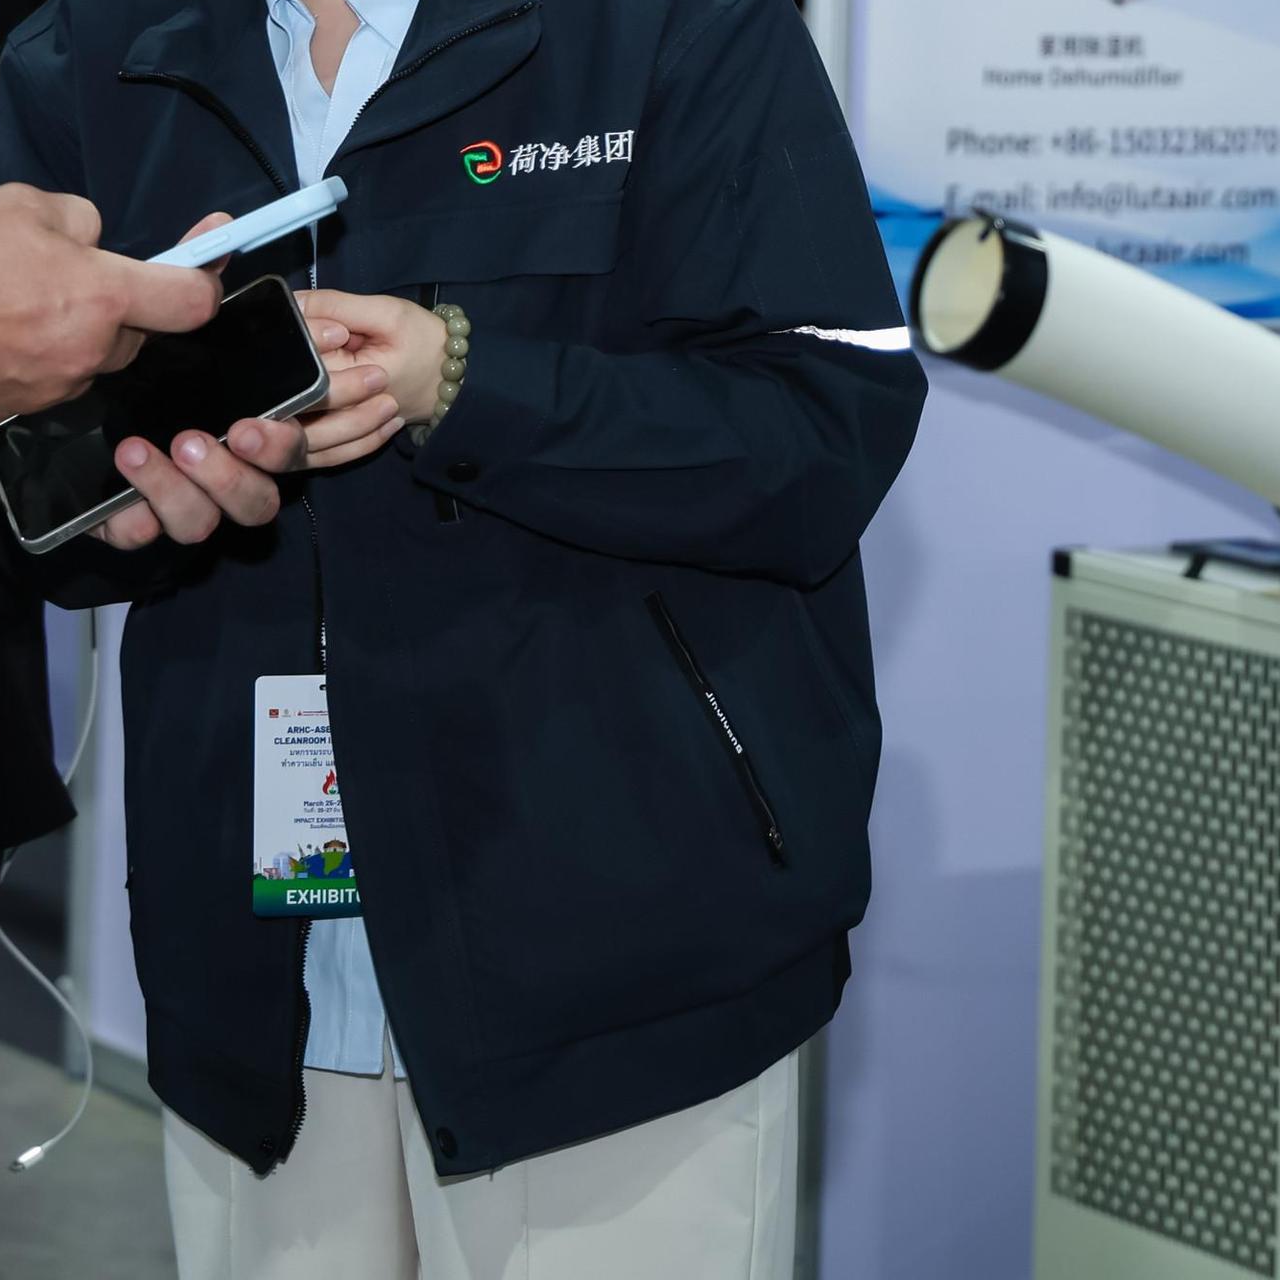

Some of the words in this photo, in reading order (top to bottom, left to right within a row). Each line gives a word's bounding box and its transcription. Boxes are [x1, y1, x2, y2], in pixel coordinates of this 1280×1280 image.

[983, 67, 1044, 87] Home
[1049, 66, 1183, 88] Dehumidifier
[508, 129, 635, 176] 荷净集团
[946, 128, 1040, 156] Phone:
[1046, 181, 1280, 216] info@lutaair.com
[274, 736, 327, 746] CLEANROOM
[287, 725, 332, 735] ARHC-ASE
[286, 888, 362, 905] EXHIBIT
